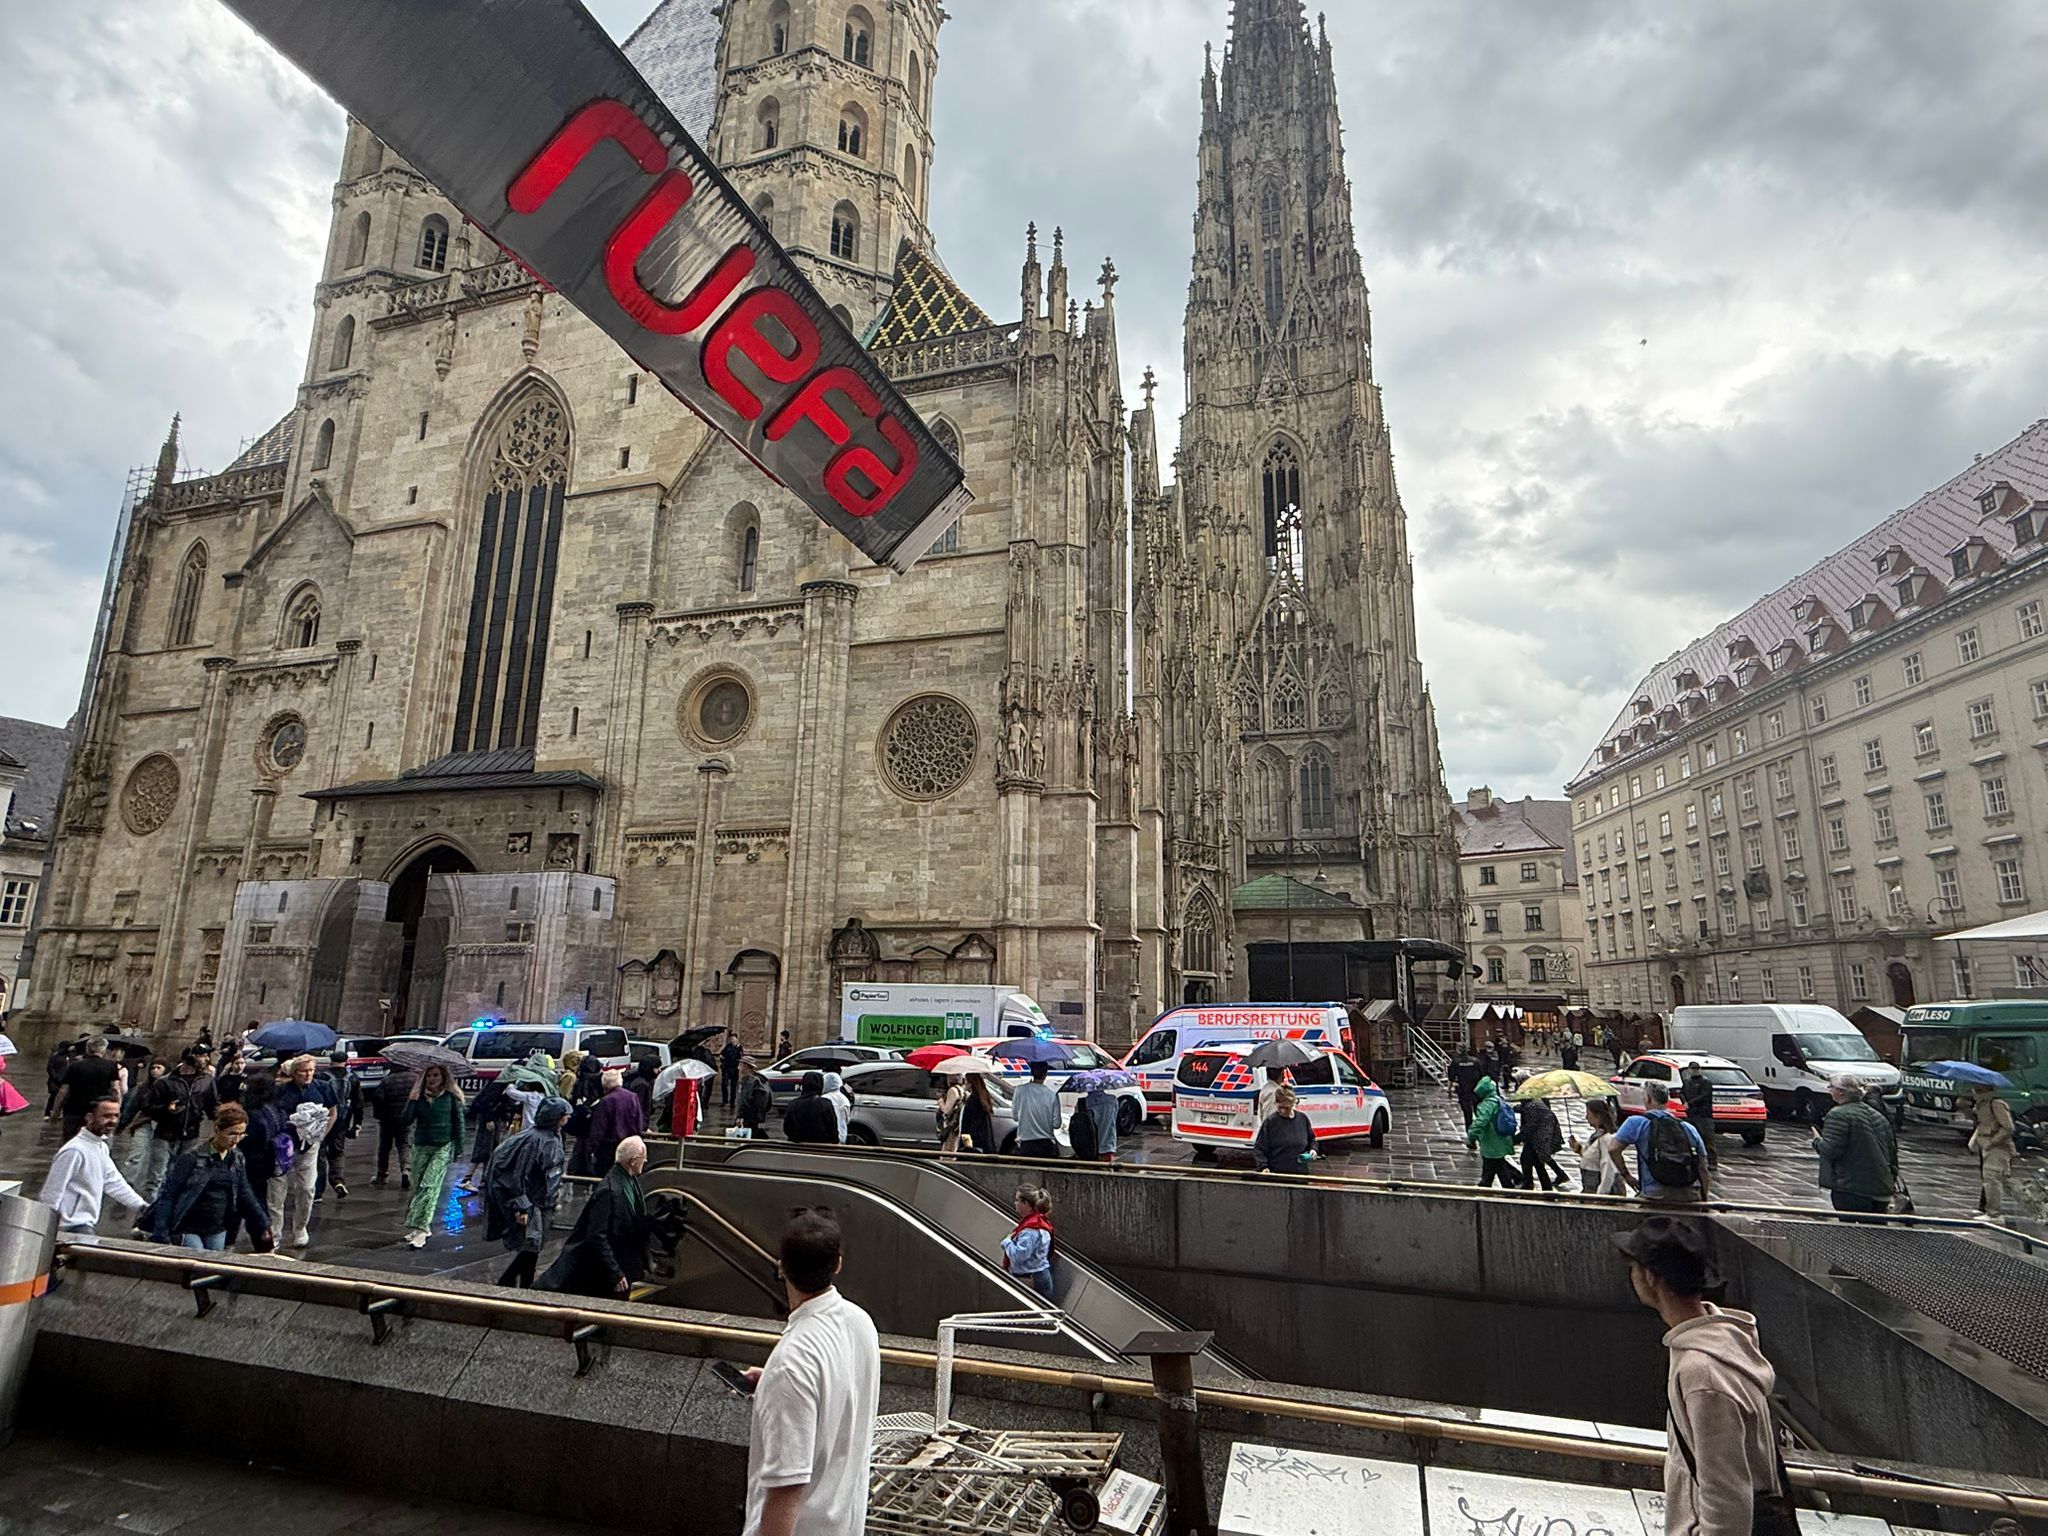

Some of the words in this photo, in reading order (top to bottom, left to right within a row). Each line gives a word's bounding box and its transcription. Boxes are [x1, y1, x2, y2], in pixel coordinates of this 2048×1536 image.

[507, 99, 918, 518] ruefa
[1198, 1013, 1321, 1026] BERUFSRETTUNG
[1909, 1010, 1924, 1020] der
[1925, 1010, 1951, 1021] LESO
[870, 1024, 940, 1036] WOLFINGER
[1254, 1030, 1280, 1040] 144
[1191, 1062, 1209, 1073] 144
[1902, 1075, 1955, 1091] LESONITZKY
